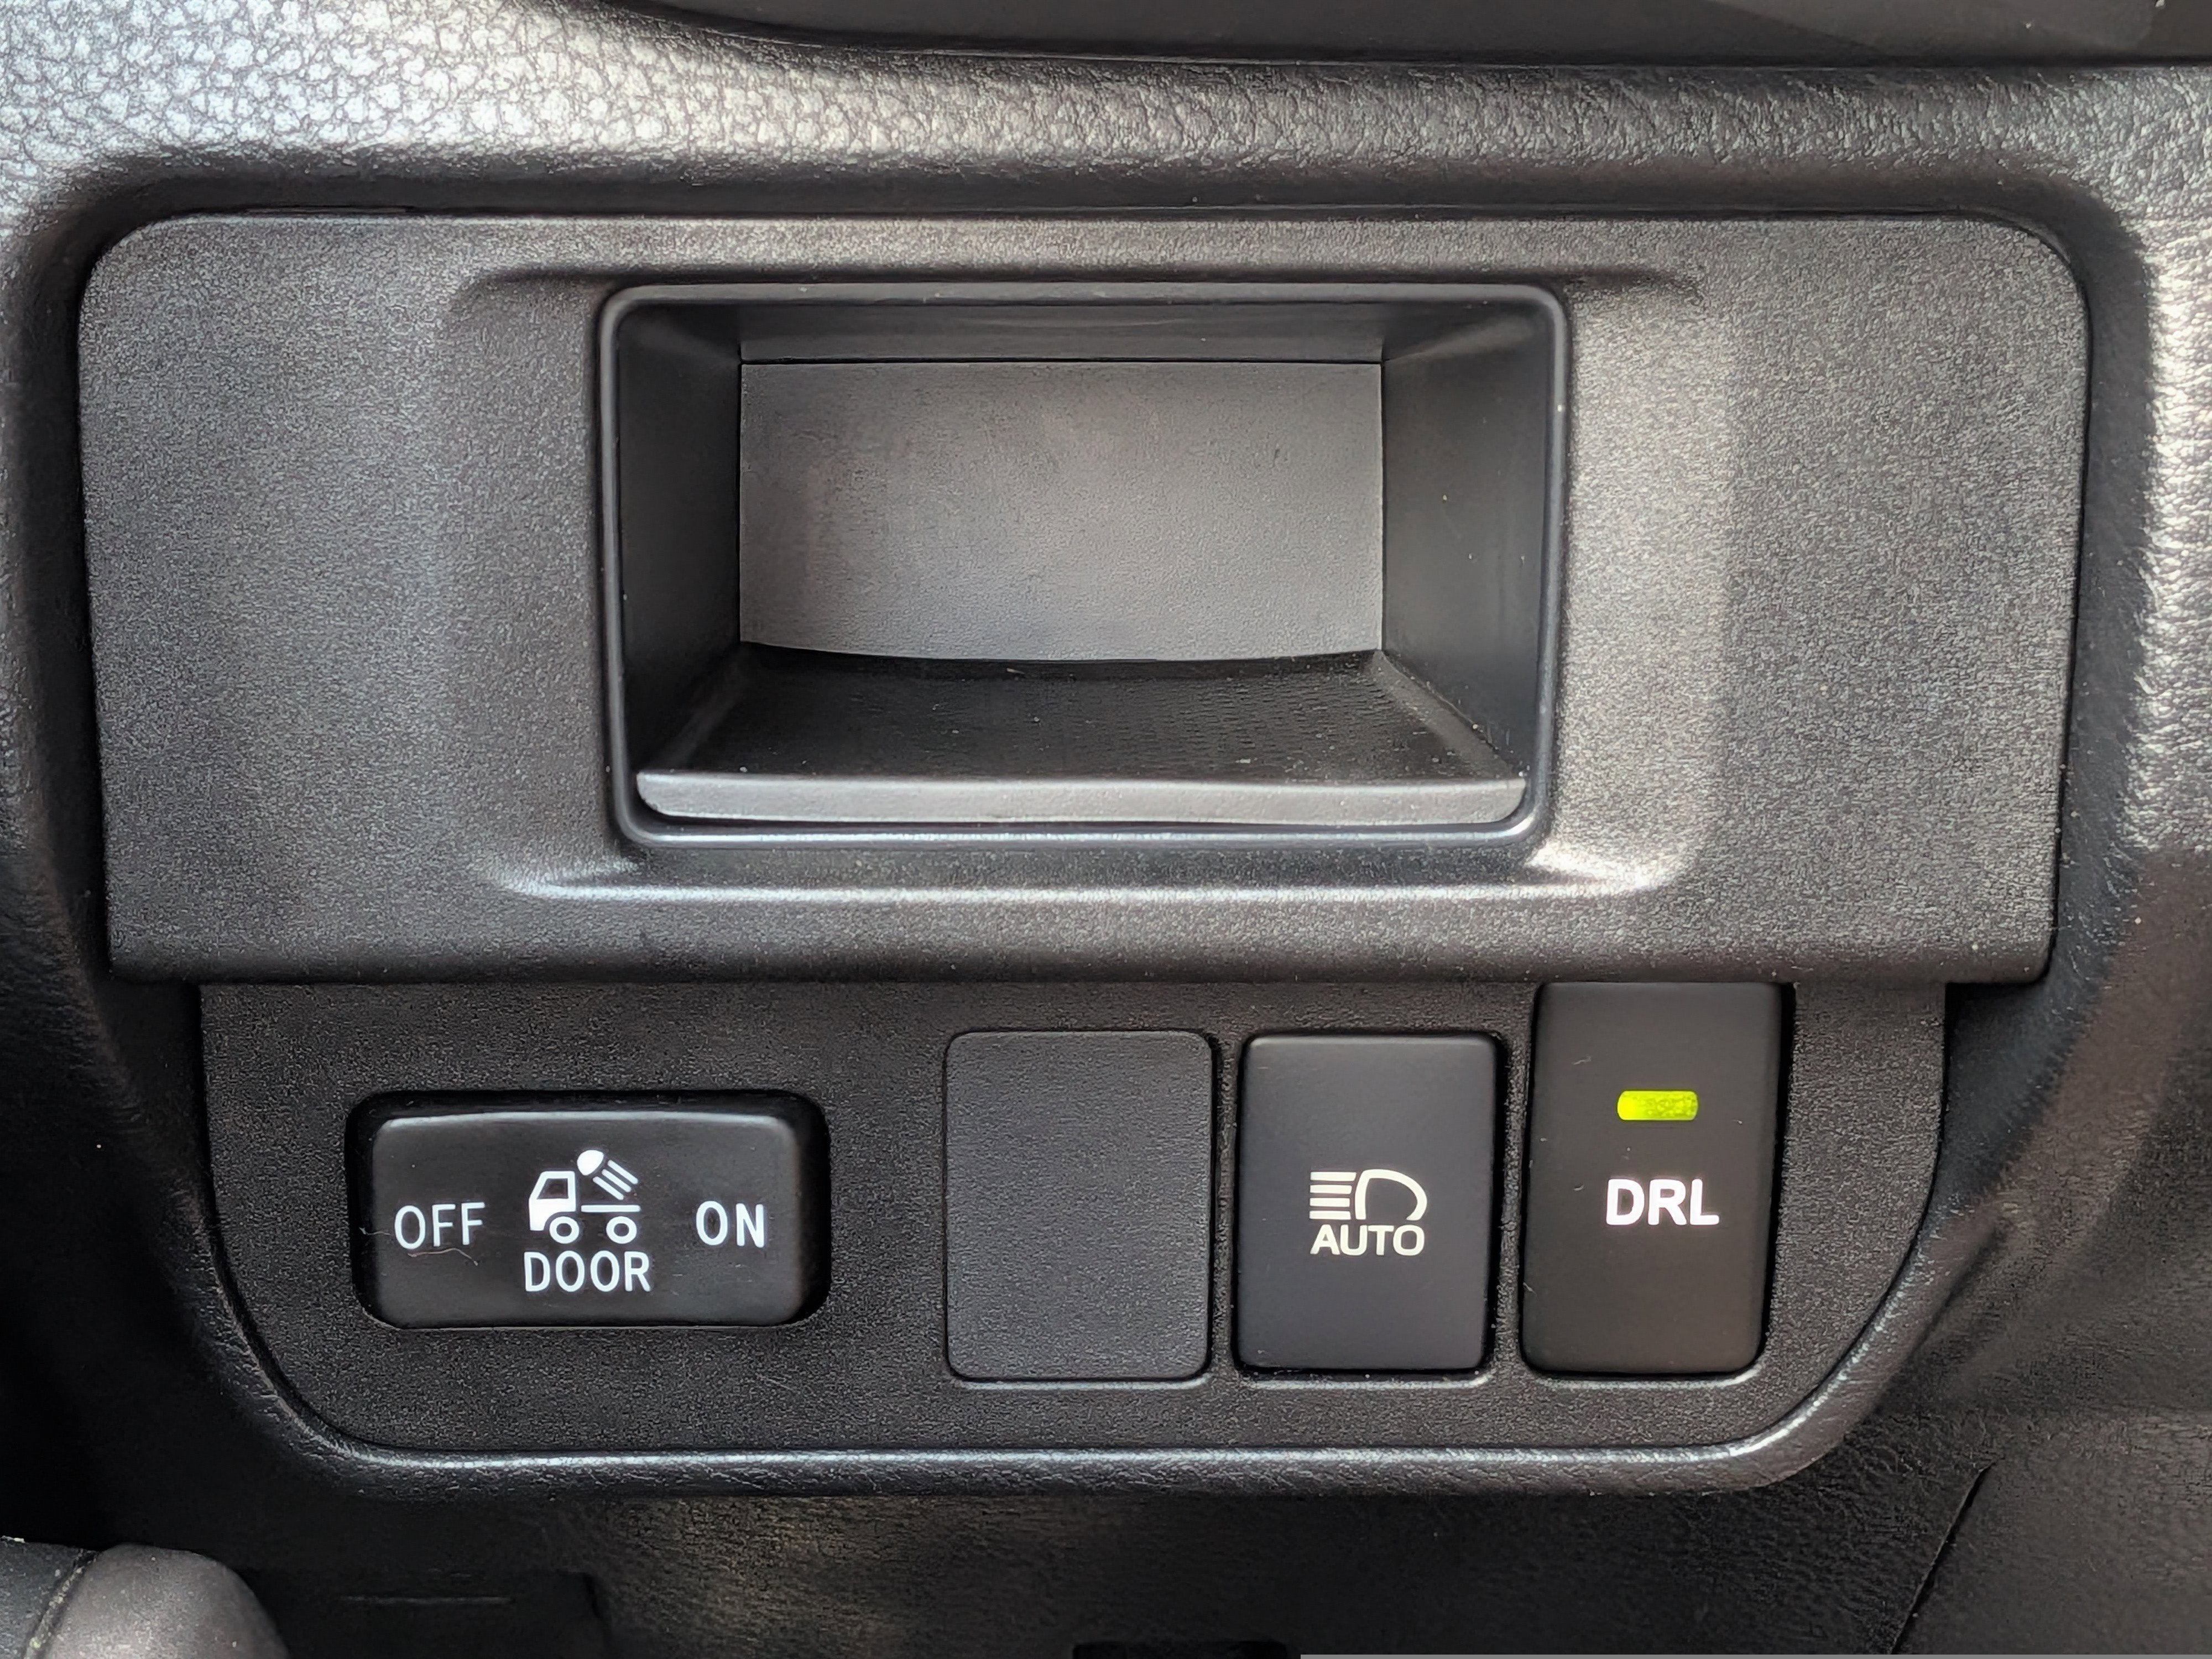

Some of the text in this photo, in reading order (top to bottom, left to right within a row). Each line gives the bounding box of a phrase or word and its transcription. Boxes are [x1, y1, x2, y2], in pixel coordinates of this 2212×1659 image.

[393, 1201, 486, 1250] OFF
[695, 1200, 766, 1249] ON
[1605, 1177, 1720, 1226] DRL
[1310, 1223, 1426, 1257] AUTO
[523, 1249, 652, 1293] DOOR
